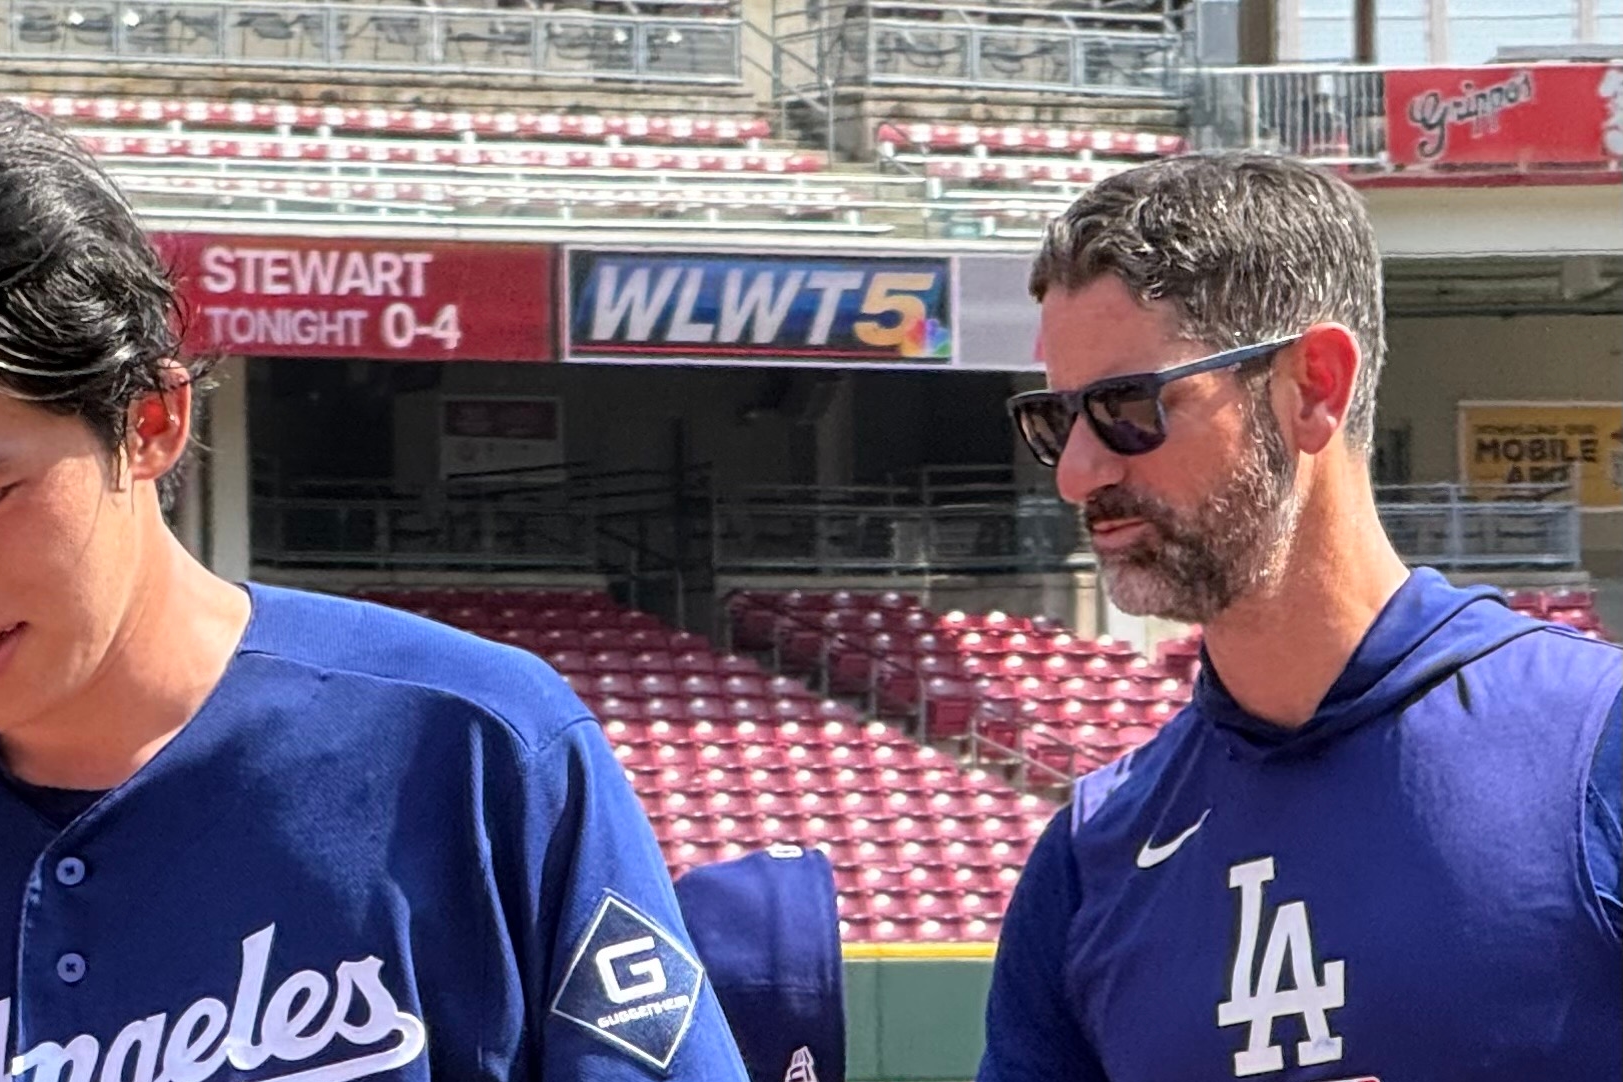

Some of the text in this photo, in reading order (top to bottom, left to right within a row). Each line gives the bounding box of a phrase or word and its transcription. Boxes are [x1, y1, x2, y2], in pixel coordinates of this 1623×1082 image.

[201, 246, 433, 298] STEWART
[203, 302, 462, 351] TONIGHT 0-4
[1475, 438, 1599, 464] MOBILE
[595, 936, 667, 1004] G
[1217, 856, 1346, 1078] LA
